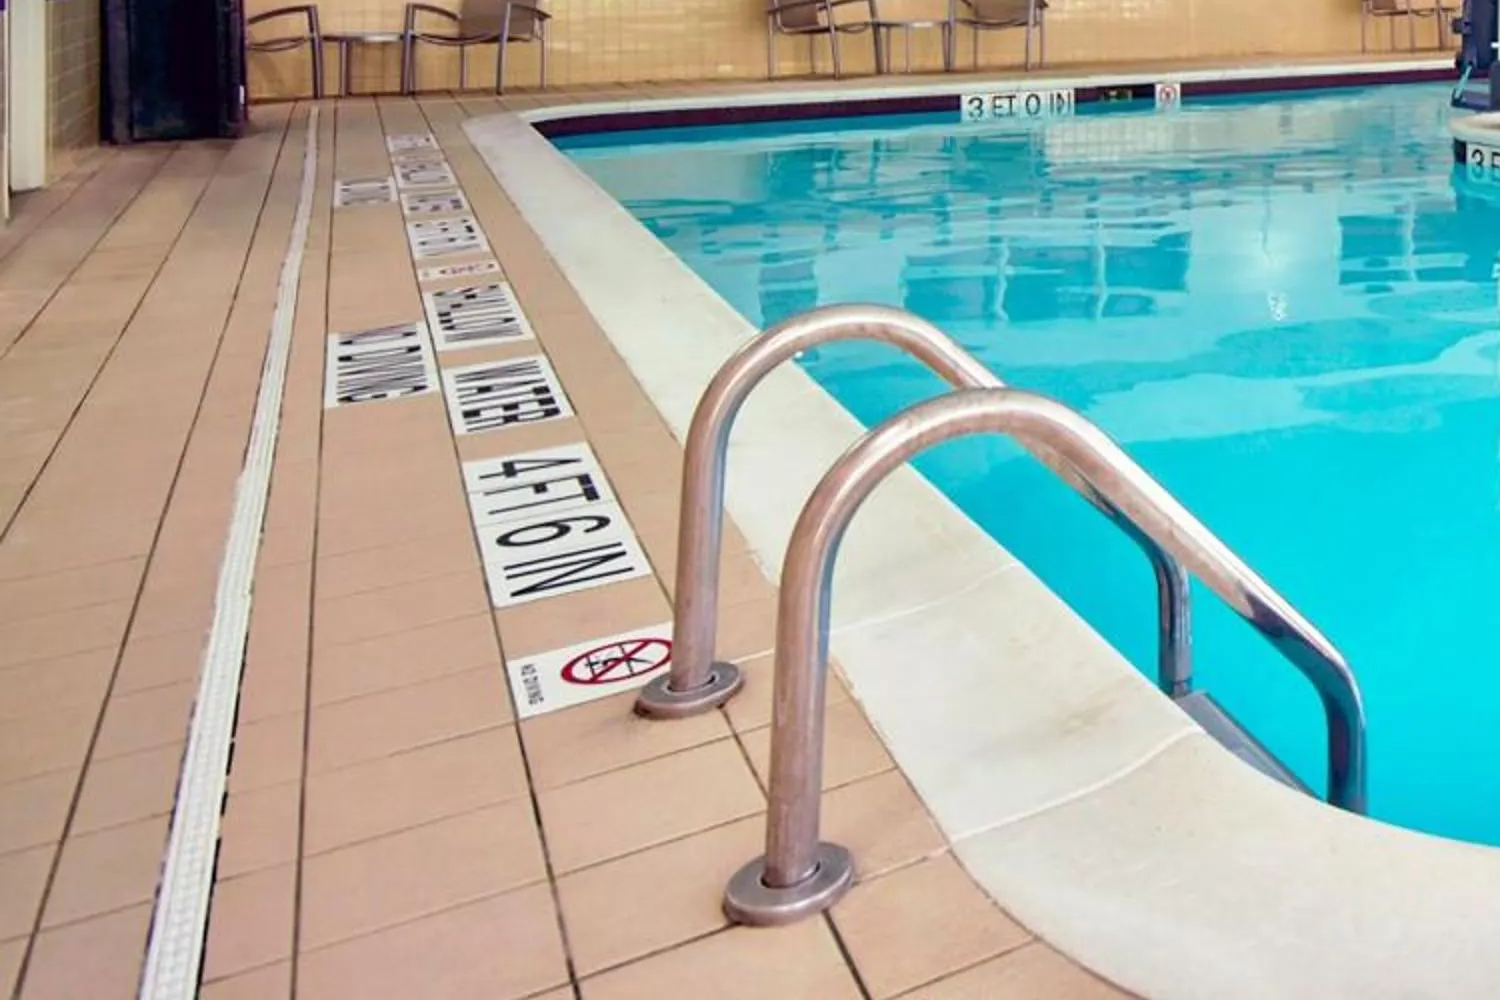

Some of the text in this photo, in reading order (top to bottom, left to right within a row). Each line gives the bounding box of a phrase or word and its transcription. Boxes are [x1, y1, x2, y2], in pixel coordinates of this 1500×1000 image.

[968, 97, 984, 117] 3
[1472, 149, 1484, 173] 3
[336, 345, 429, 403] DIVING
[454, 360, 561, 432] WATER
[479, 457, 582, 479] 4
[483, 473, 600, 515] FT
[496, 515, 611, 547] 6
[503, 541, 635, 598] IN
